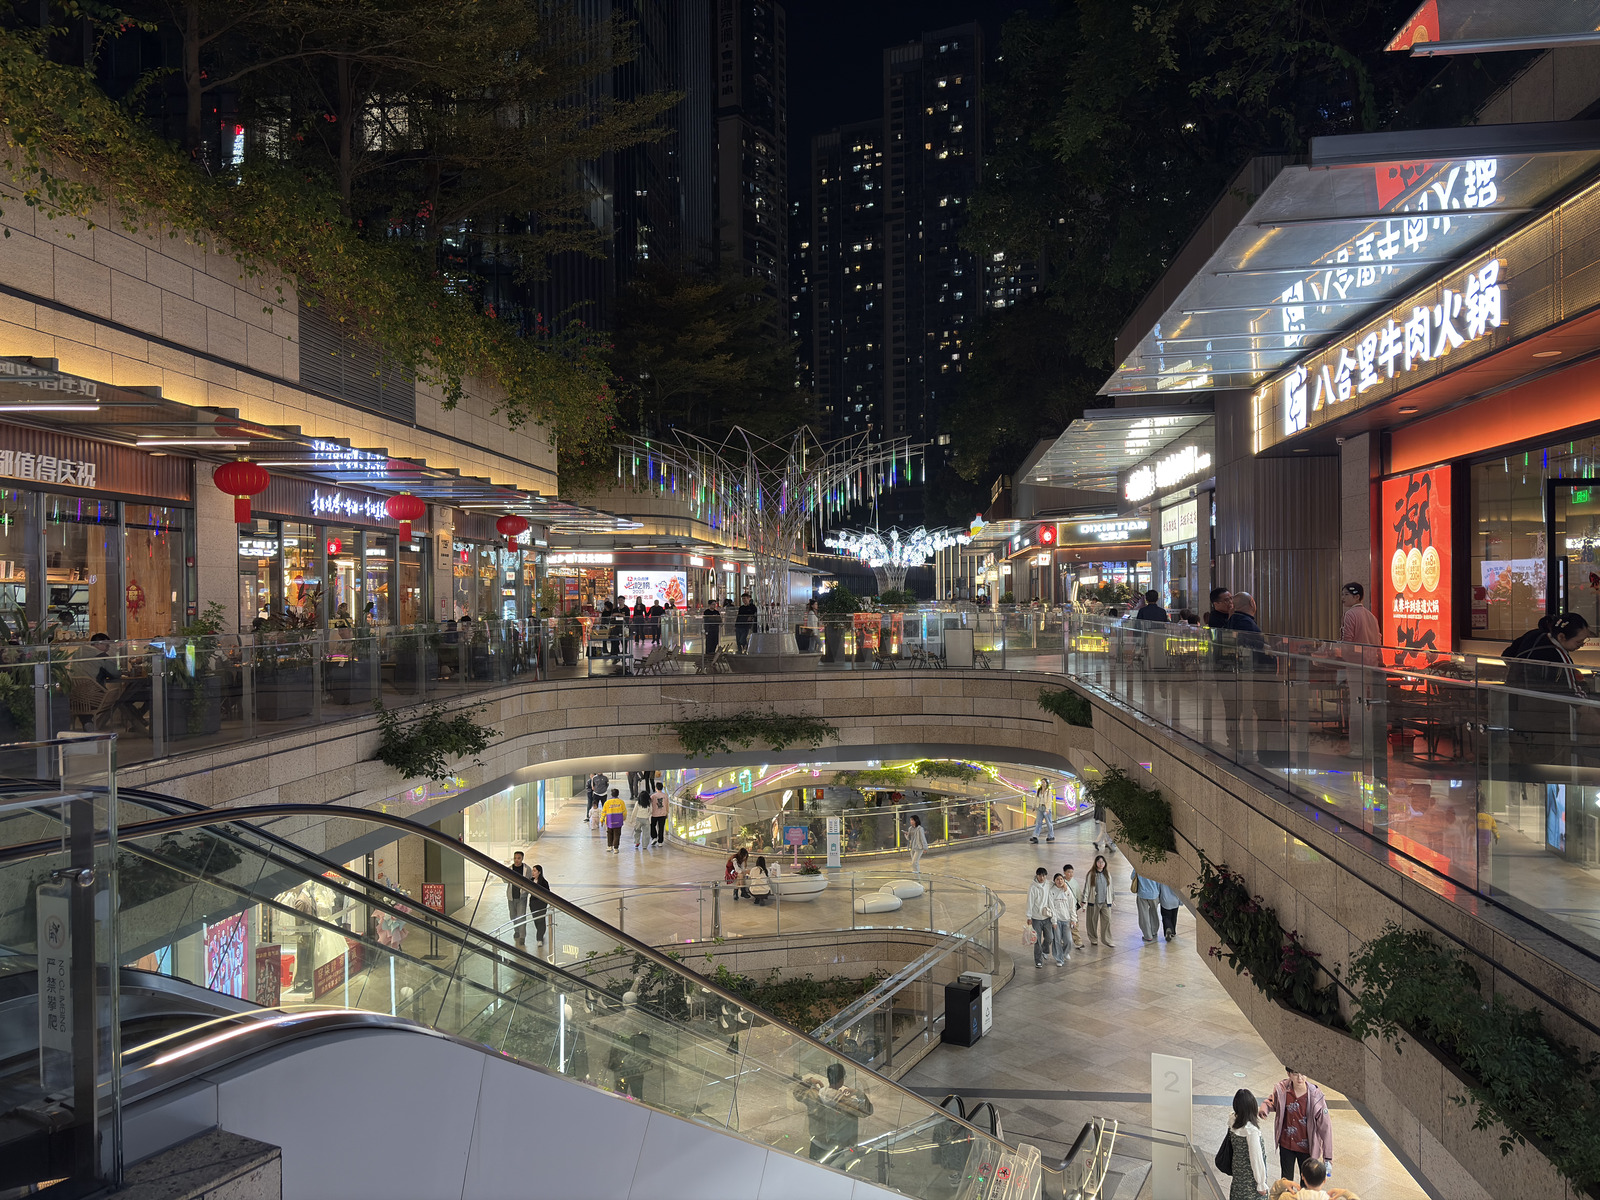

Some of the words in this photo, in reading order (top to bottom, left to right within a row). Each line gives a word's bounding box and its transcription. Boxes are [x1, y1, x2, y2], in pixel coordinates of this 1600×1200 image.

[1313, 258, 1501, 411] 八合里牛肉火锅
[46, 957, 58, 1031] 严禁攀爬
[58, 959, 65, 977] NO
[58, 979, 66, 1033] CLIMBING
[1164, 1071, 1180, 1094] 2
